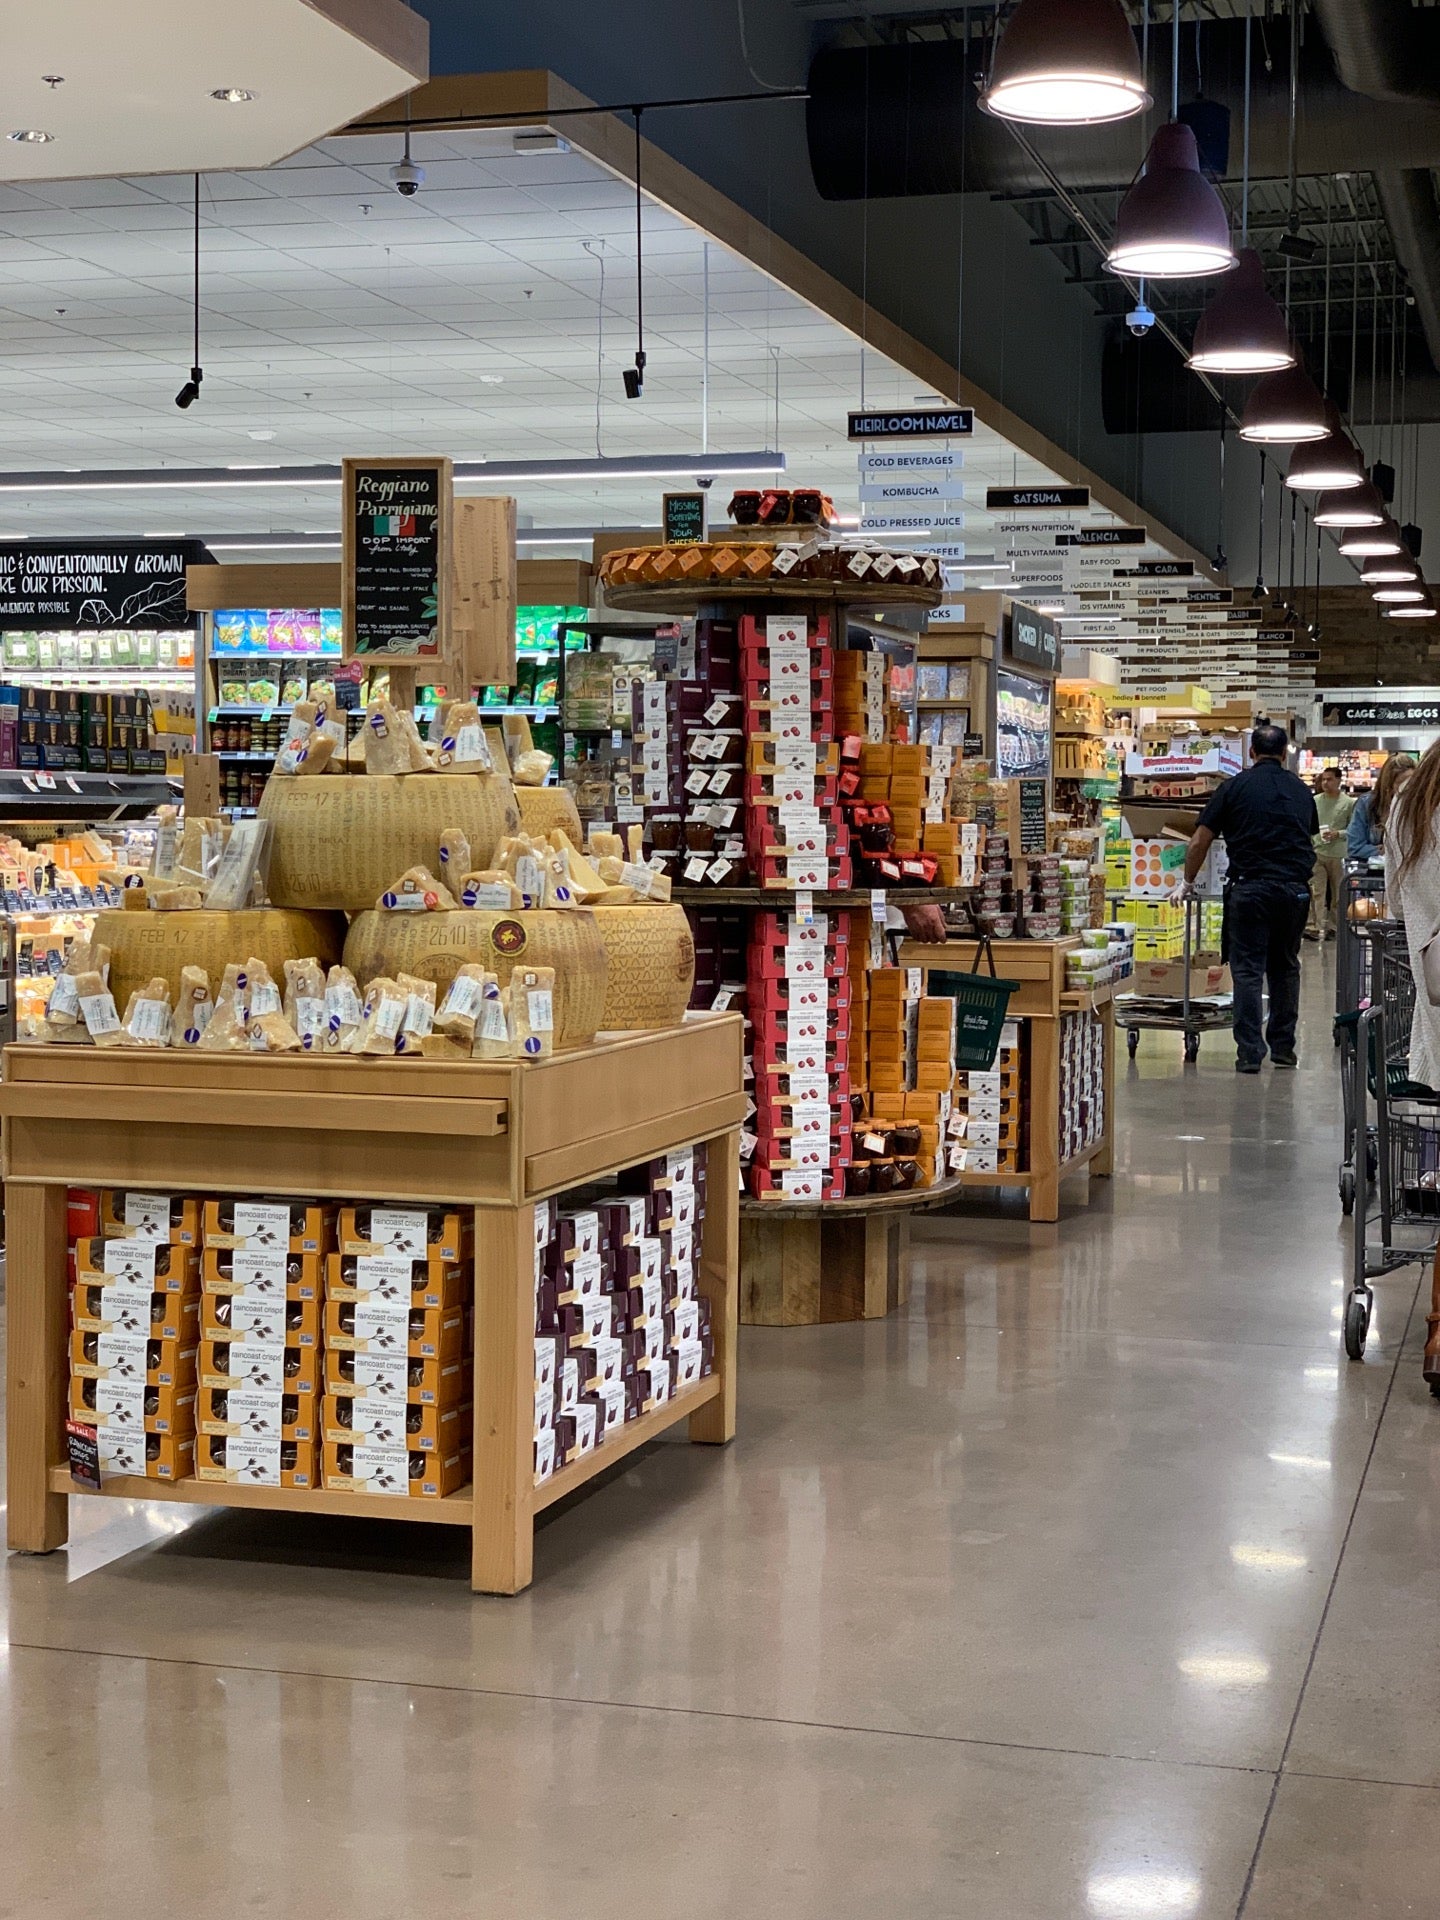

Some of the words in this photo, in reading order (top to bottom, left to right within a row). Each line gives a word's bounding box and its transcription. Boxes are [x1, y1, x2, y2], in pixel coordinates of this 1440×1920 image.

[854, 417, 924, 433] HEIRLOOM
[926, 415, 967, 431] NAVEL
[868, 458, 895, 467] COLD
[897, 456, 953, 466] BEVERAGES
[356, 475, 430, 502] Reggiano
[882, 487, 940, 497] KOMBUCHA
[1013, 493, 1062, 504] SATSUMA
[356, 499, 438, 527] Parmigiano
[861, 519, 887, 528] COLD
[889, 518, 931, 527] PRESSED
[933, 517, 961, 526] JUICE
[1032, 524, 1075, 532] NUTRITION
[669, 528, 693, 538] YOUR
[1074, 533, 1121, 543] VALENCIA
[362, 537, 391, 545] DOP
[396, 536, 432, 544] IMPORT
[368, 544, 392, 555] from
[26, 554, 128, 574] CONVENTOINALLY
[134, 554, 183, 574] GROWN
[1154, 565, 1179, 574] CARA
[1010, 574, 1064, 582] SUPERFOODS
[21, 575, 49, 594] OUR
[52, 575, 108, 594] PASSION.
[37, 601, 70, 613] POSSIBLE
[1346, 709, 1376, 718] CAGE
[1407, 708, 1438, 718] EGGS
[139, 929, 166, 944] FEB
